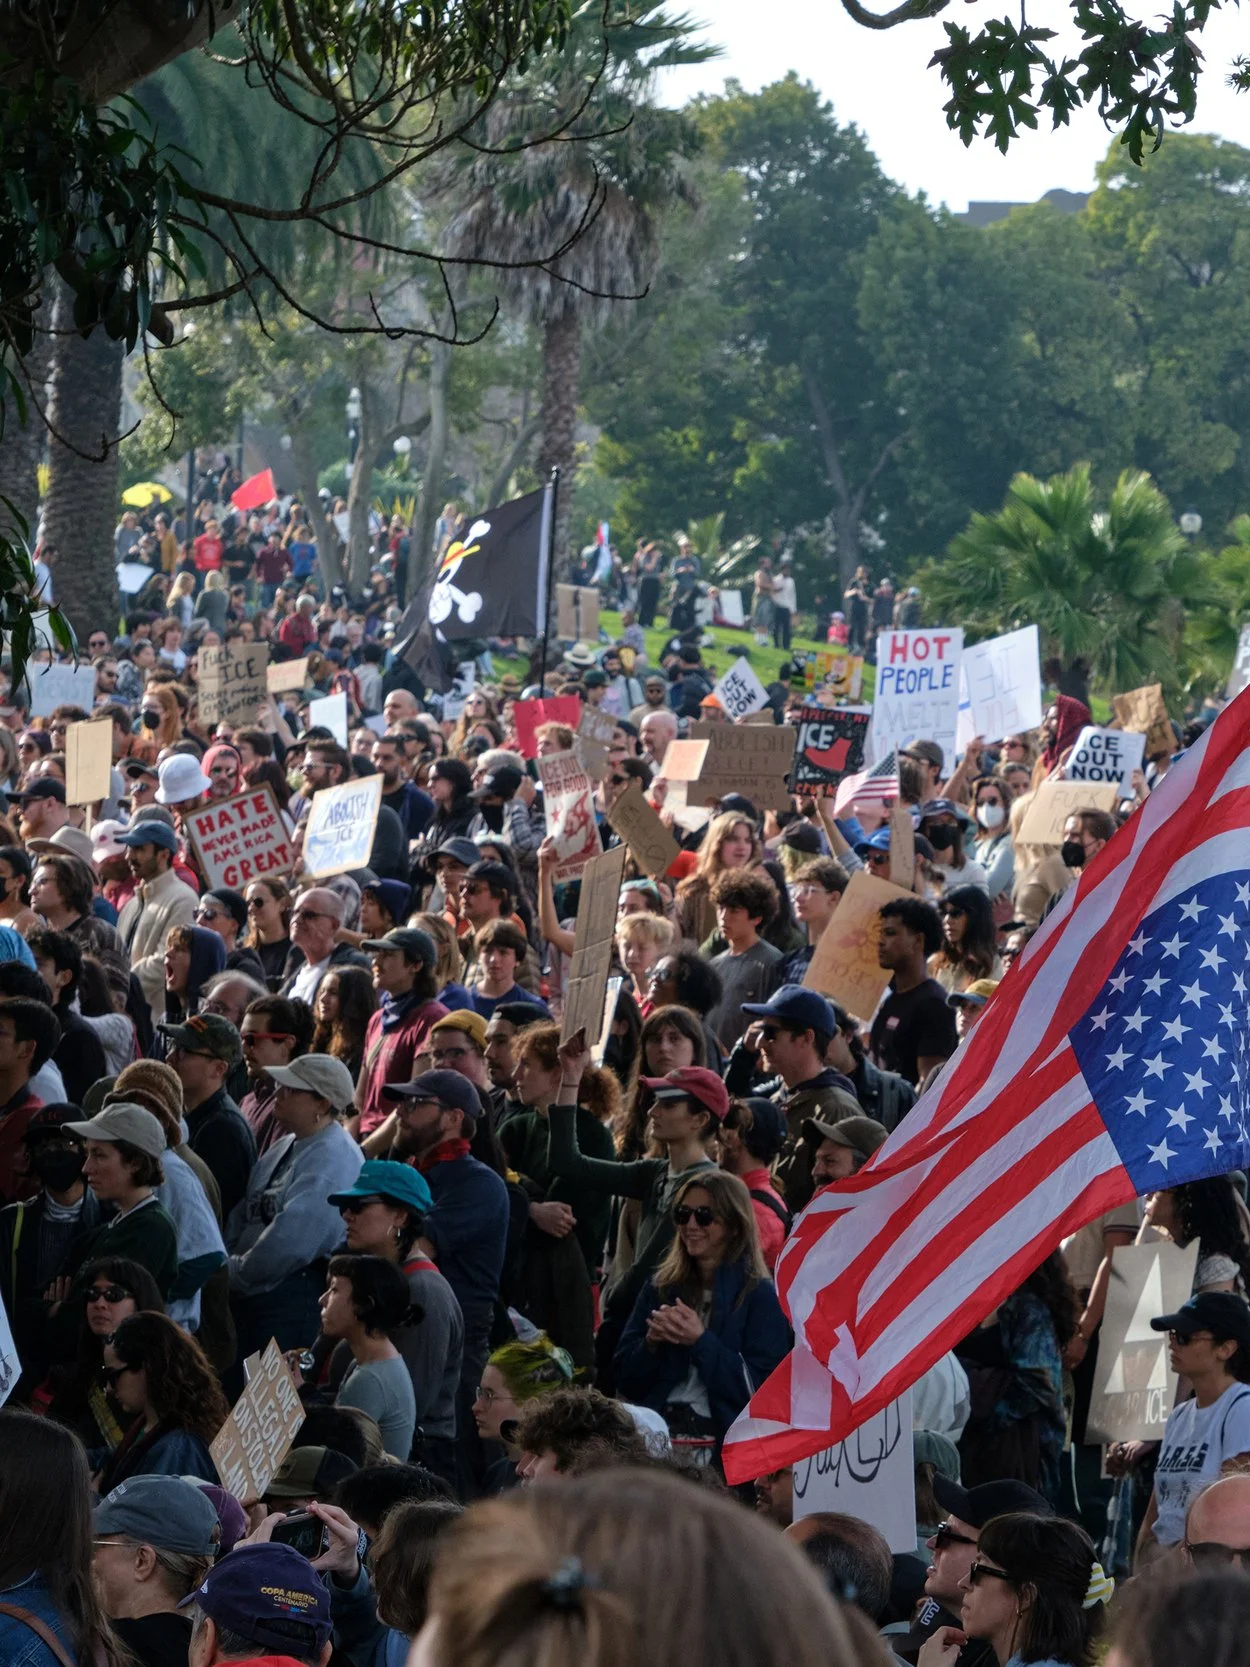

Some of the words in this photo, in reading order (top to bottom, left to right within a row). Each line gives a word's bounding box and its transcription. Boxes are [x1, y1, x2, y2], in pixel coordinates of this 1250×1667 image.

[890, 635, 951, 664] HOT
[220, 657, 260, 684] ICE
[721, 671, 738, 696] ICE
[879, 664, 954, 695] PEOPLE
[727, 681, 748, 709] OUT
[710, 728, 785, 752] ABOLISH
[797, 722, 835, 753] ICE
[1071, 765, 1124, 783] NOW
[1076, 751, 1123, 768] OUT
[544, 779, 563, 798] FOR
[562, 773, 588, 794] GOOD
[195, 793, 269, 837] HATE
[323, 792, 369, 829] ABOLISH
[202, 831, 238, 852] NEVER
[241, 813, 277, 837] MADE
[222, 843, 290, 887] GREAT
[261, 1344, 281, 1381] NO
[276, 1375, 297, 1423] ONE
[249, 1368, 286, 1471] ILLEGAL
[1145, 1388, 1169, 1424] ICE
[220, 1441, 249, 1500] LAND
[260, 1585, 286, 1598] COPA
[273, 1595, 309, 1609] CENTENARIO
